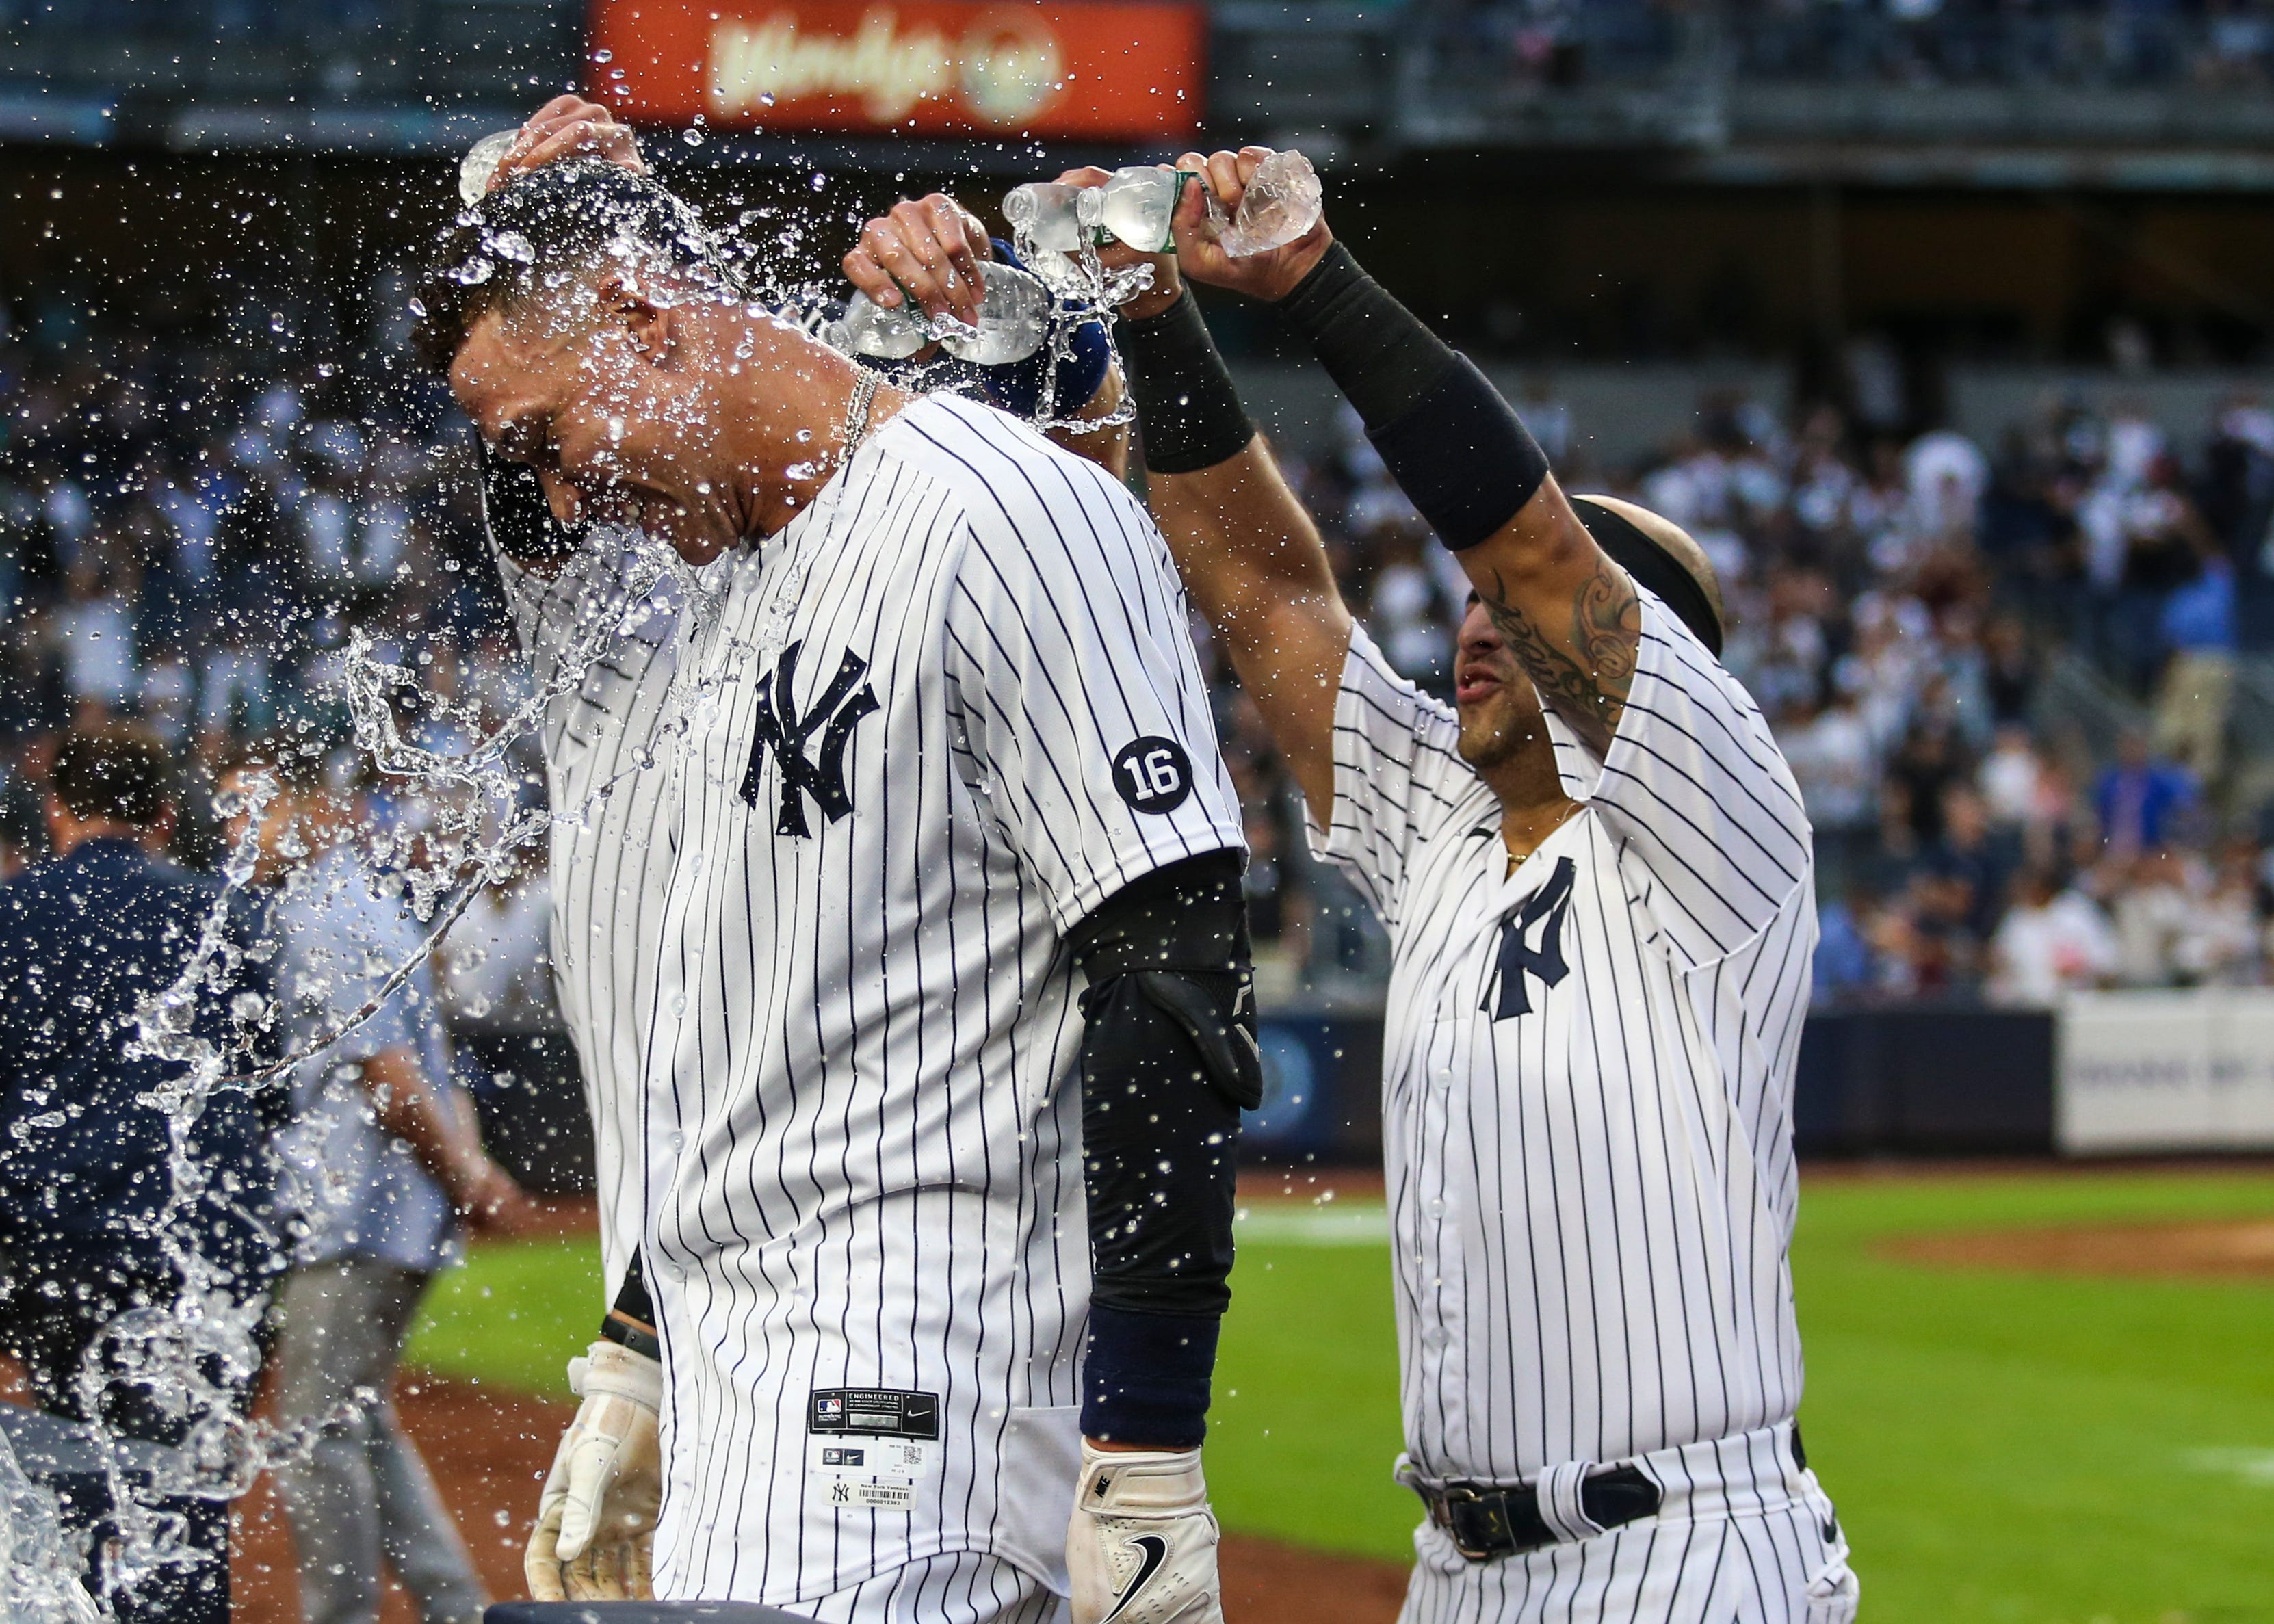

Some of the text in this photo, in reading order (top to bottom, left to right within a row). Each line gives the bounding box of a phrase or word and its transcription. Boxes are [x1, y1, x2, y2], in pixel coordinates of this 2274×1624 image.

[739, 638, 880, 839] NY
[1123, 748, 1181, 801] 16
[848, 1393, 900, 1402] ENGINEERED
[832, 1482, 850, 1502] NY
[1094, 1475, 1110, 1498] NIKE
